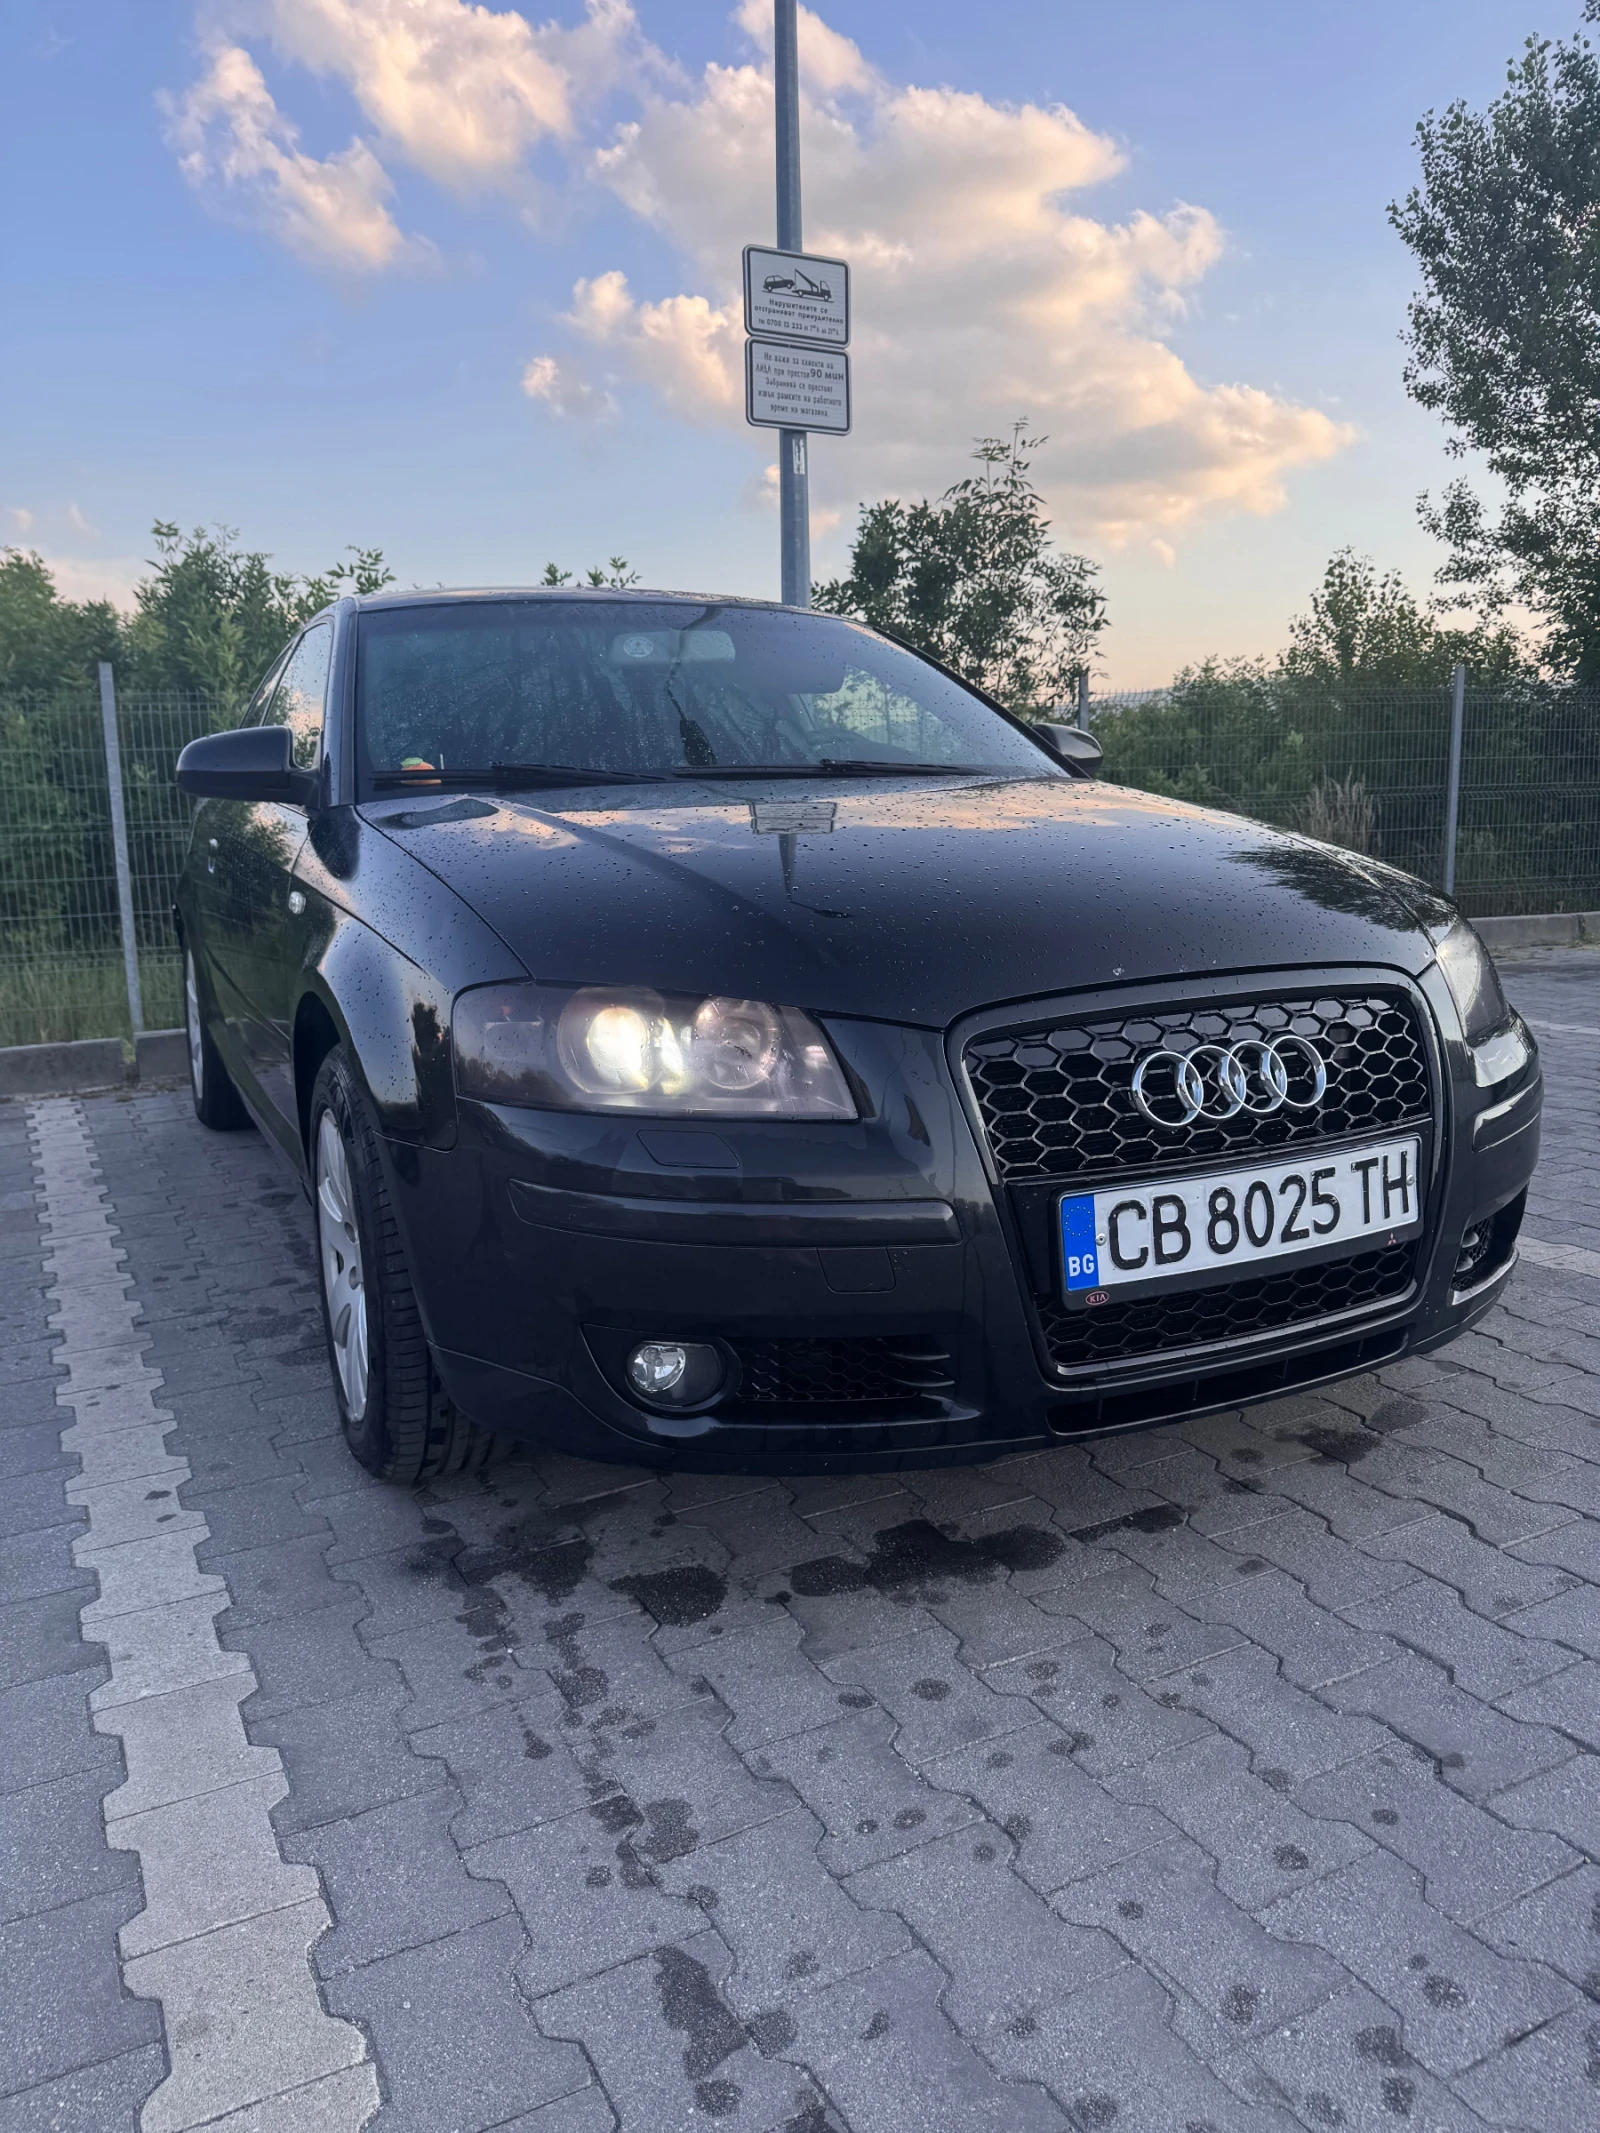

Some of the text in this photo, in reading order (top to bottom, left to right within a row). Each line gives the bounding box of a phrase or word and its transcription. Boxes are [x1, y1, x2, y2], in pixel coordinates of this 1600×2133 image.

[769, 298, 817, 312] Нарушителите
[754, 305, 843, 324] отстраняват принудително
[767, 318, 781, 327] 0700
[764, 352, 772, 361] Не
[774, 355, 790, 364] важи
[792, 357, 799, 365] за
[802, 359, 825, 368] клиенти
[756, 363, 772, 374] ЛИДЛ
[774, 367, 784, 377] при
[810, 368, 822, 378] 90
[825, 372, 844, 381] мин
[765, 377, 797, 388] Забранява
[799, 382, 806, 390] се
[758, 390, 842, 407] извън рамките на работното
[770, 403, 788, 413] време
[790, 406, 798, 414] на
[1107, 1150, 1410, 1271] CB 8025 TH
[1068, 1253, 1095, 1277] BG
[1089, 1294, 1106, 1303] KIA
